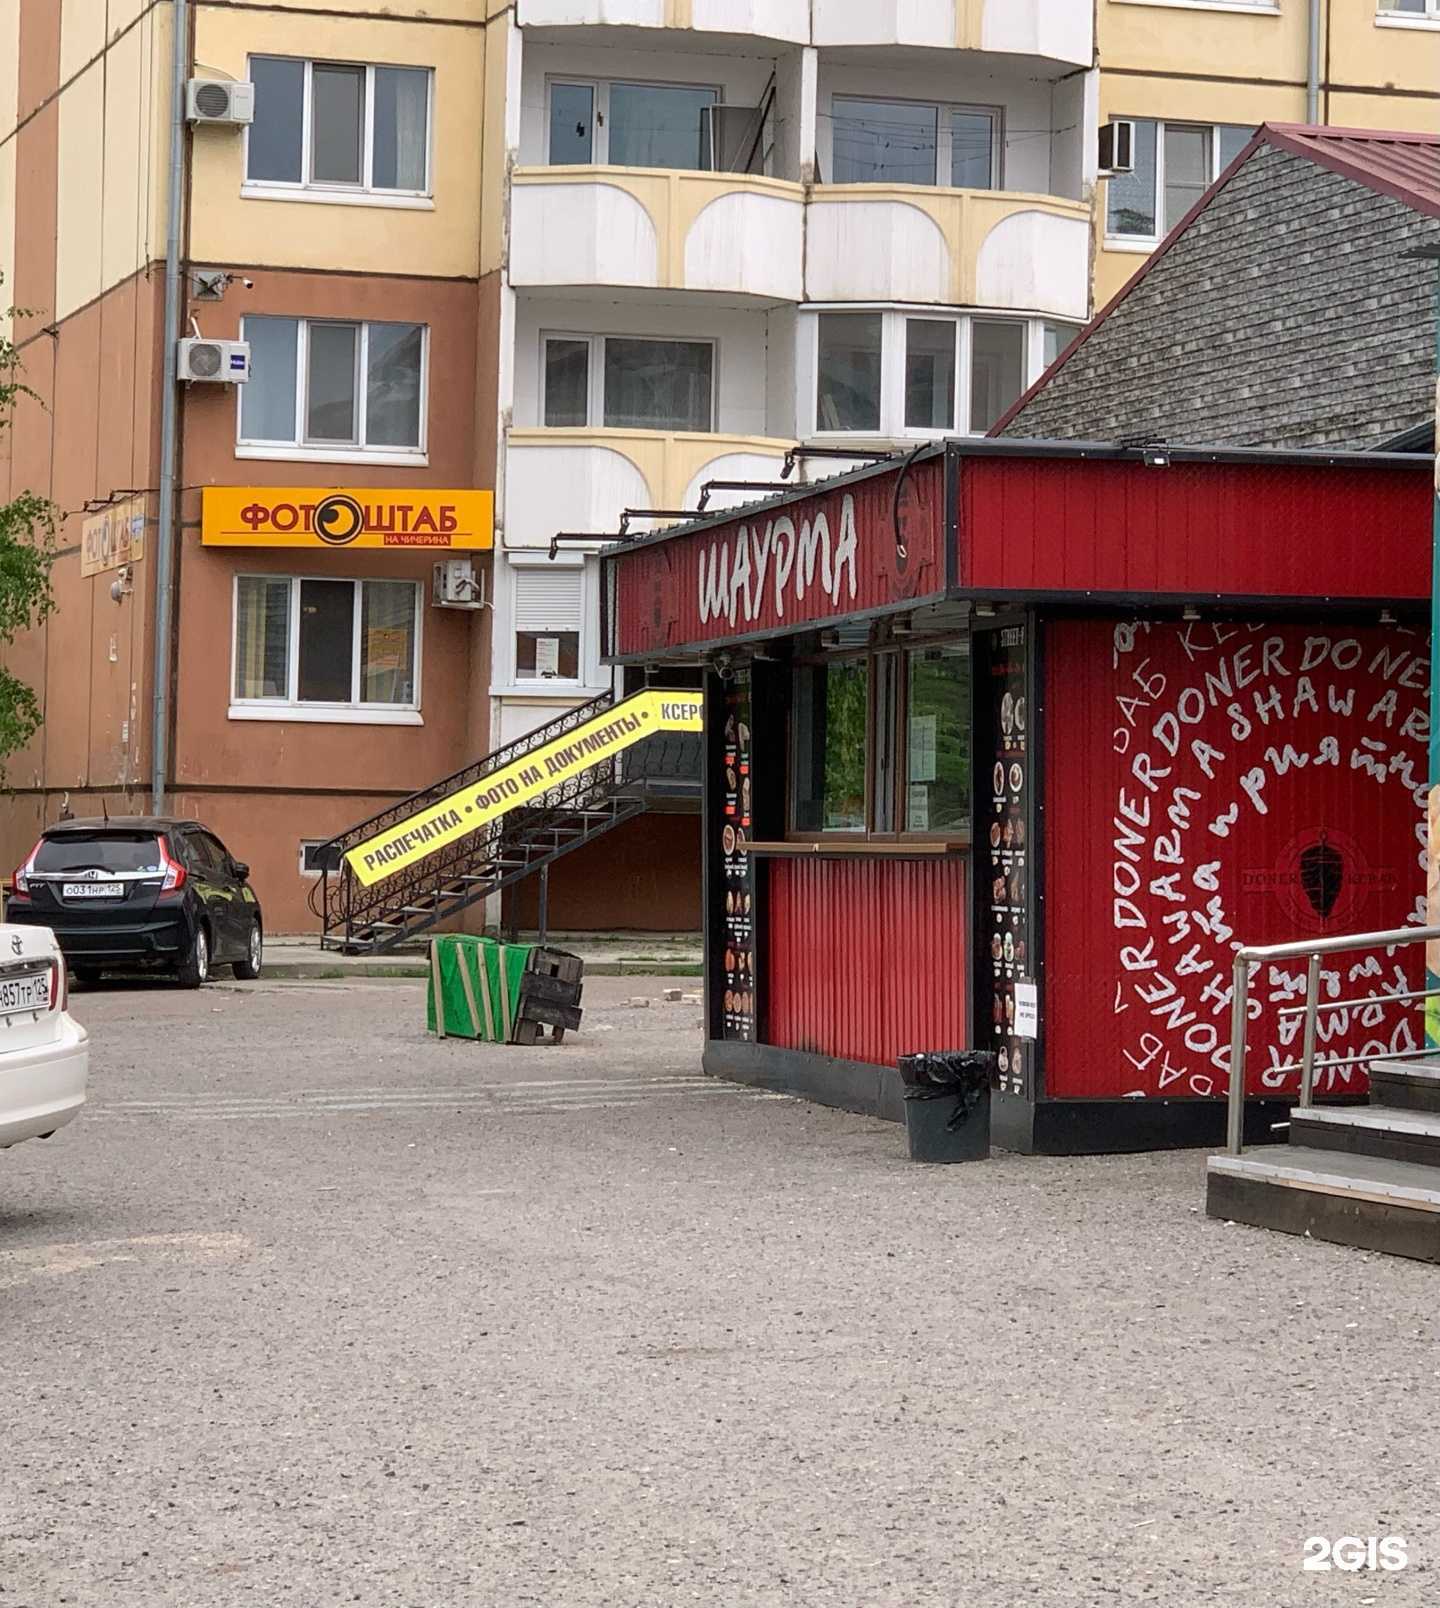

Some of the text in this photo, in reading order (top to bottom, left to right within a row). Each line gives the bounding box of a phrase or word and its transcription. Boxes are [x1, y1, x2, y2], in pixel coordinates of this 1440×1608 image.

[241, 494, 458, 546] ФОТОШТАБ
[385, 535, 449, 545] НА ЧИЧЕРИНА
[700, 494, 858, 629] ШАУРМА
[363, 810, 463, 872] РАСПЕЧАТКА
[474, 782, 520, 811] ФОТО
[520, 768, 544, 789] НА
[544, 711, 643, 778] ДОКУМЕНТЫ
[1114, 752, 1172, 929] DONER
[1152, 635, 1293, 758] DONER
[1299, 635, 1431, 699] DONE
